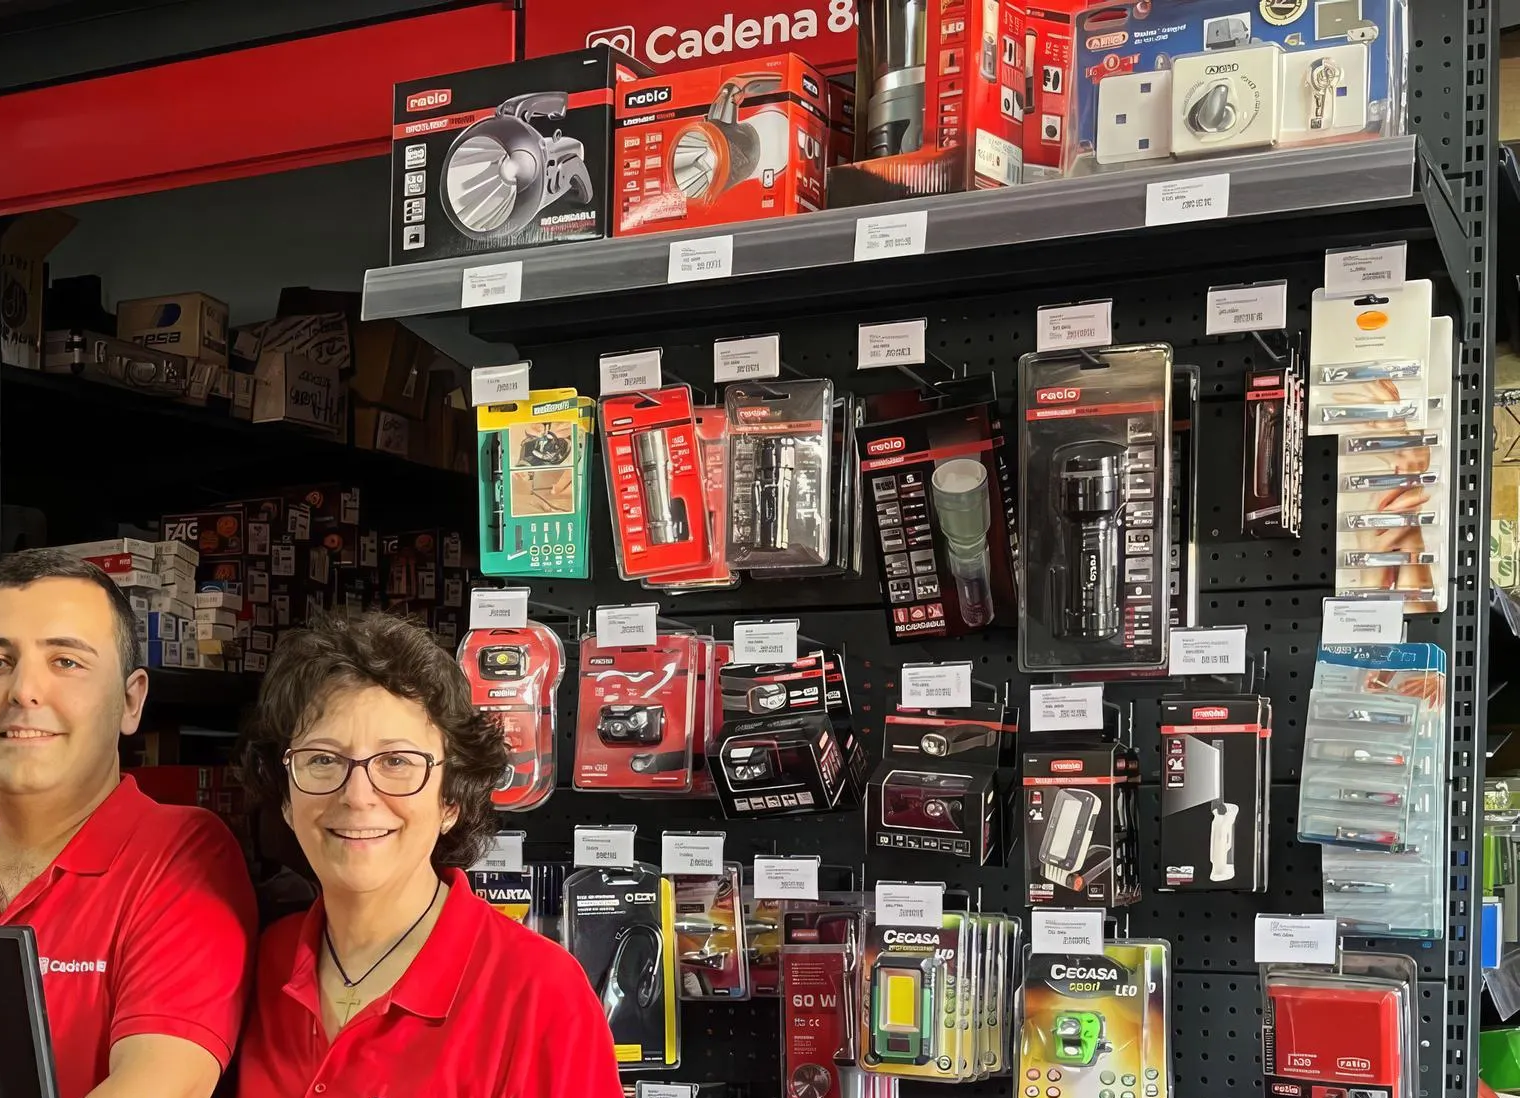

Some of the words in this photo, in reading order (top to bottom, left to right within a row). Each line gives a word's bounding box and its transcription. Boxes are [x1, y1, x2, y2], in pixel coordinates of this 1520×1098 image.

[645, 9, 818, 63] Cadena
[828, 0, 859, 33] 8
[488, 888, 532, 900] VARTA
[792, 994, 815, 1008] 60
[820, 994, 838, 1008] W
